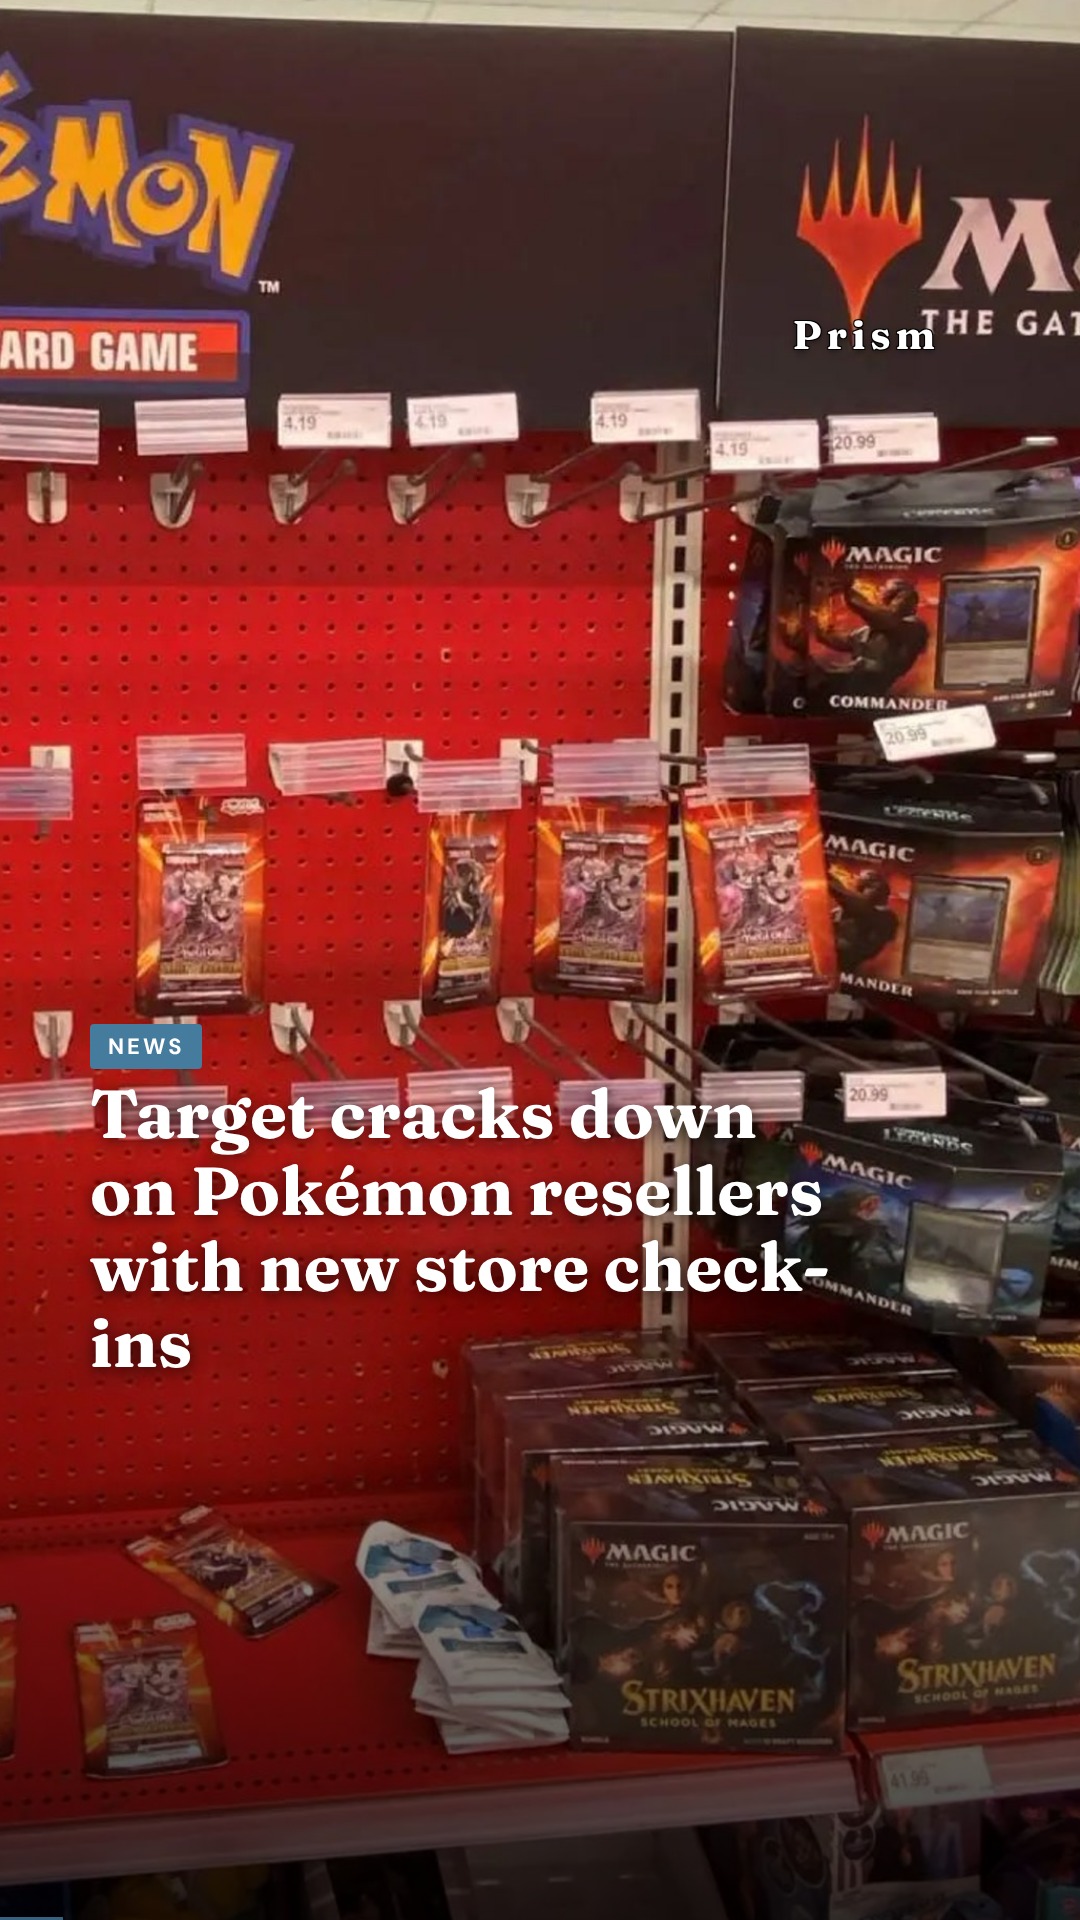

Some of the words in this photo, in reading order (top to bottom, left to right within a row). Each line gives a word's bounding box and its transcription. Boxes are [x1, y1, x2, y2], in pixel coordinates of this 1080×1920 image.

[920, 196, 1080, 297] M
[921, 309, 994, 336] THE
[90, 331, 198, 373] GAME
[283, 415, 318, 431] 4.19
[413, 413, 448, 430] 4.19
[594, 413, 629, 429] 4.19
[714, 441, 749, 457] 4.19
[833, 434, 877, 450] 20.99
[845, 546, 943, 565] MAGIC
[829, 694, 949, 712] COMMANDER
[884, 728, 928, 747] 20.99
[825, 834, 916, 863] MAGIC
[849, 1088, 889, 1103] 20.99
[822, 1153, 913, 1190] MAGIC
[899, 1405, 973, 1422] MAGIC
[647, 1421, 726, 1437] MAGIC
[626, 1471, 753, 1489] STRIXHAVEN
[971, 1470, 1054, 1488] MAGIC
[713, 1499, 800, 1513] MAGIC
[884, 1520, 971, 1545] MAGIC
[604, 1544, 698, 1563] MAGIC
[896, 1652, 1058, 1694] STRIXHAVEN
[620, 1680, 796, 1717] STRIXHAVEN
[914, 1690, 969, 1705] SCHOOL
[972, 1687, 989, 1699] OF
[994, 1683, 1040, 1696] MAGES
[640, 1717, 699, 1728] SCHOOL
[704, 1717, 721, 1728] OF
[727, 1716, 777, 1729] MAGES
[890, 1768, 930, 1789] 41.99
